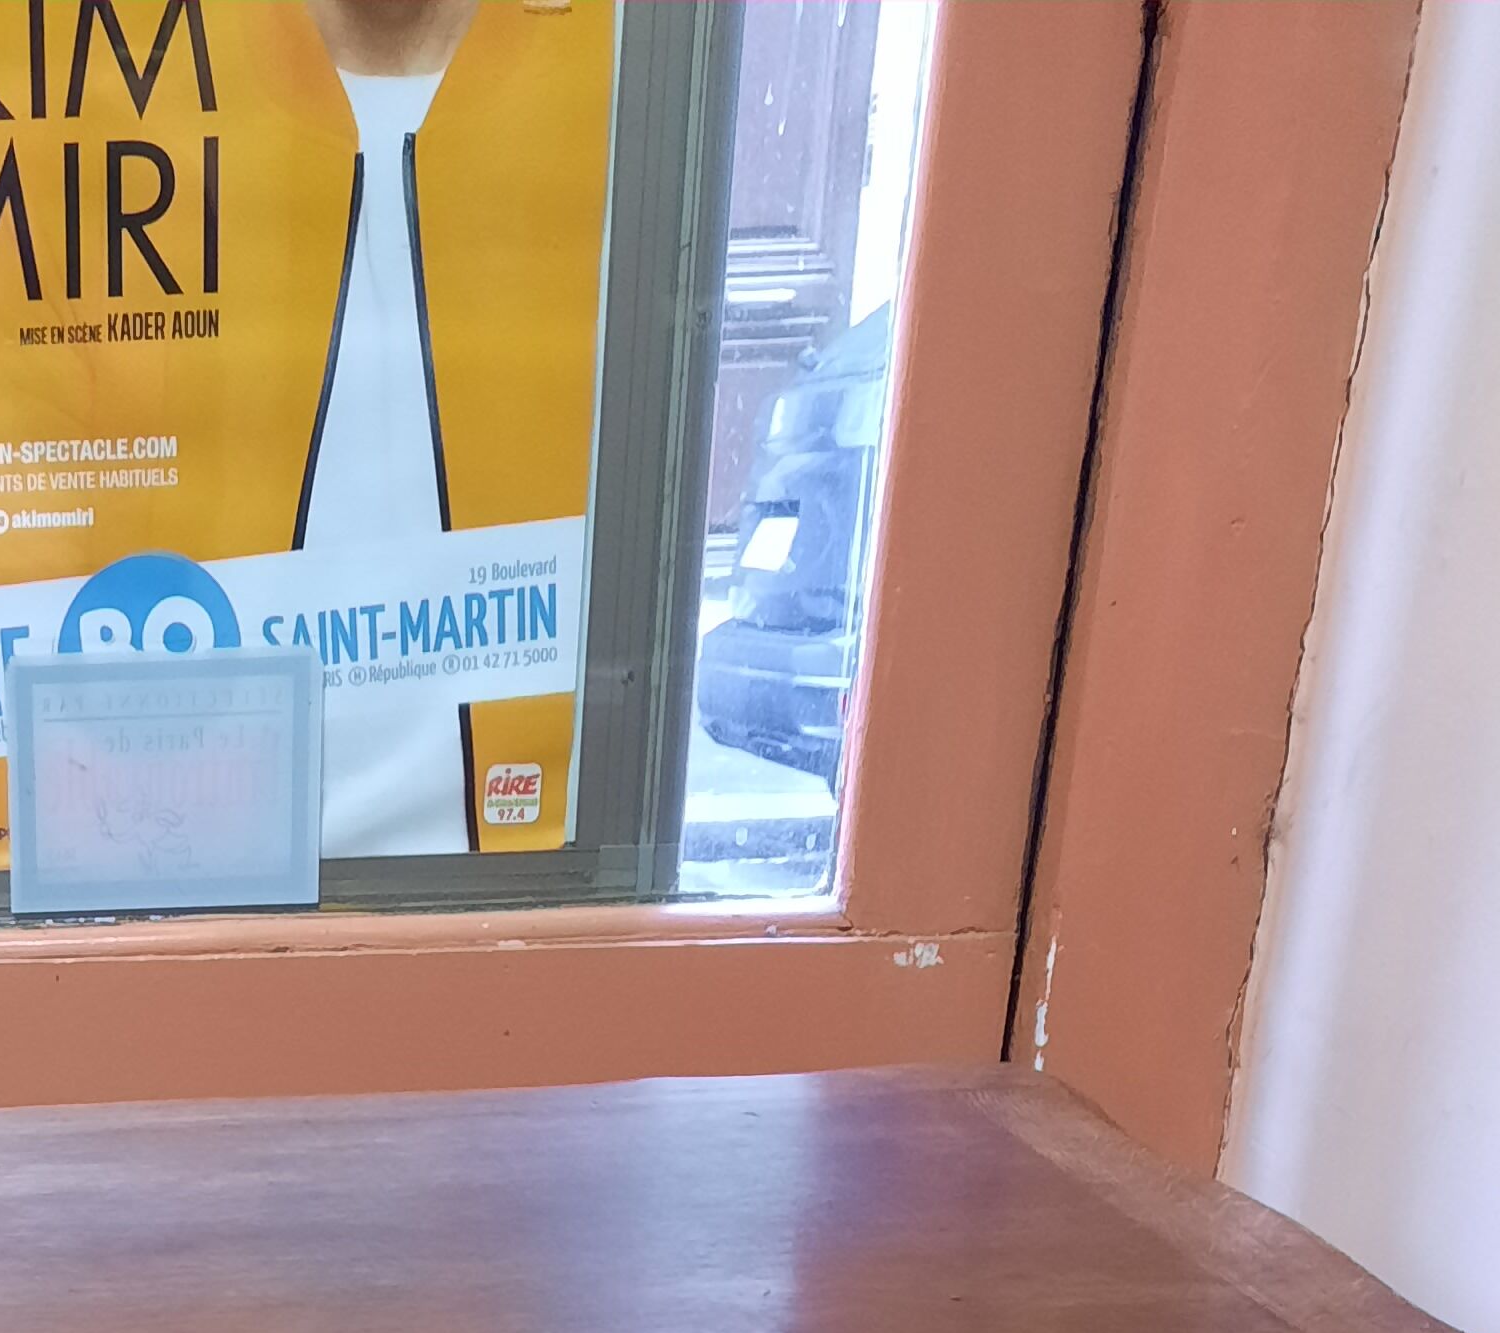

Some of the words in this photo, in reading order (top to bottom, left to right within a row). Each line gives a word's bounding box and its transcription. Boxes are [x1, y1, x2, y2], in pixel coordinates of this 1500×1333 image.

[20, 327, 47, 346] MISE
[51, 326, 64, 344] EN
[68, 321, 102, 344] SCÈNE
[107, 312, 166, 342] KADER
[172, 309, 219, 339] AOUN
[27, 472, 46, 492] DE
[49, 470, 96, 490] VENTE
[100, 467, 179, 488] HABITUELS
[11, 507, 95, 529] akimomiri
[468, 566, 487, 584] 19
[491, 555, 557, 581] Boulevard
[369, 661, 437, 685] République
[462, 658, 479, 672] 01
[483, 656, 500, 670] 42
[502, 651, 521, 668] 71
[522, 646, 558, 666] 5000
[498, 808, 525, 821] 97.4
